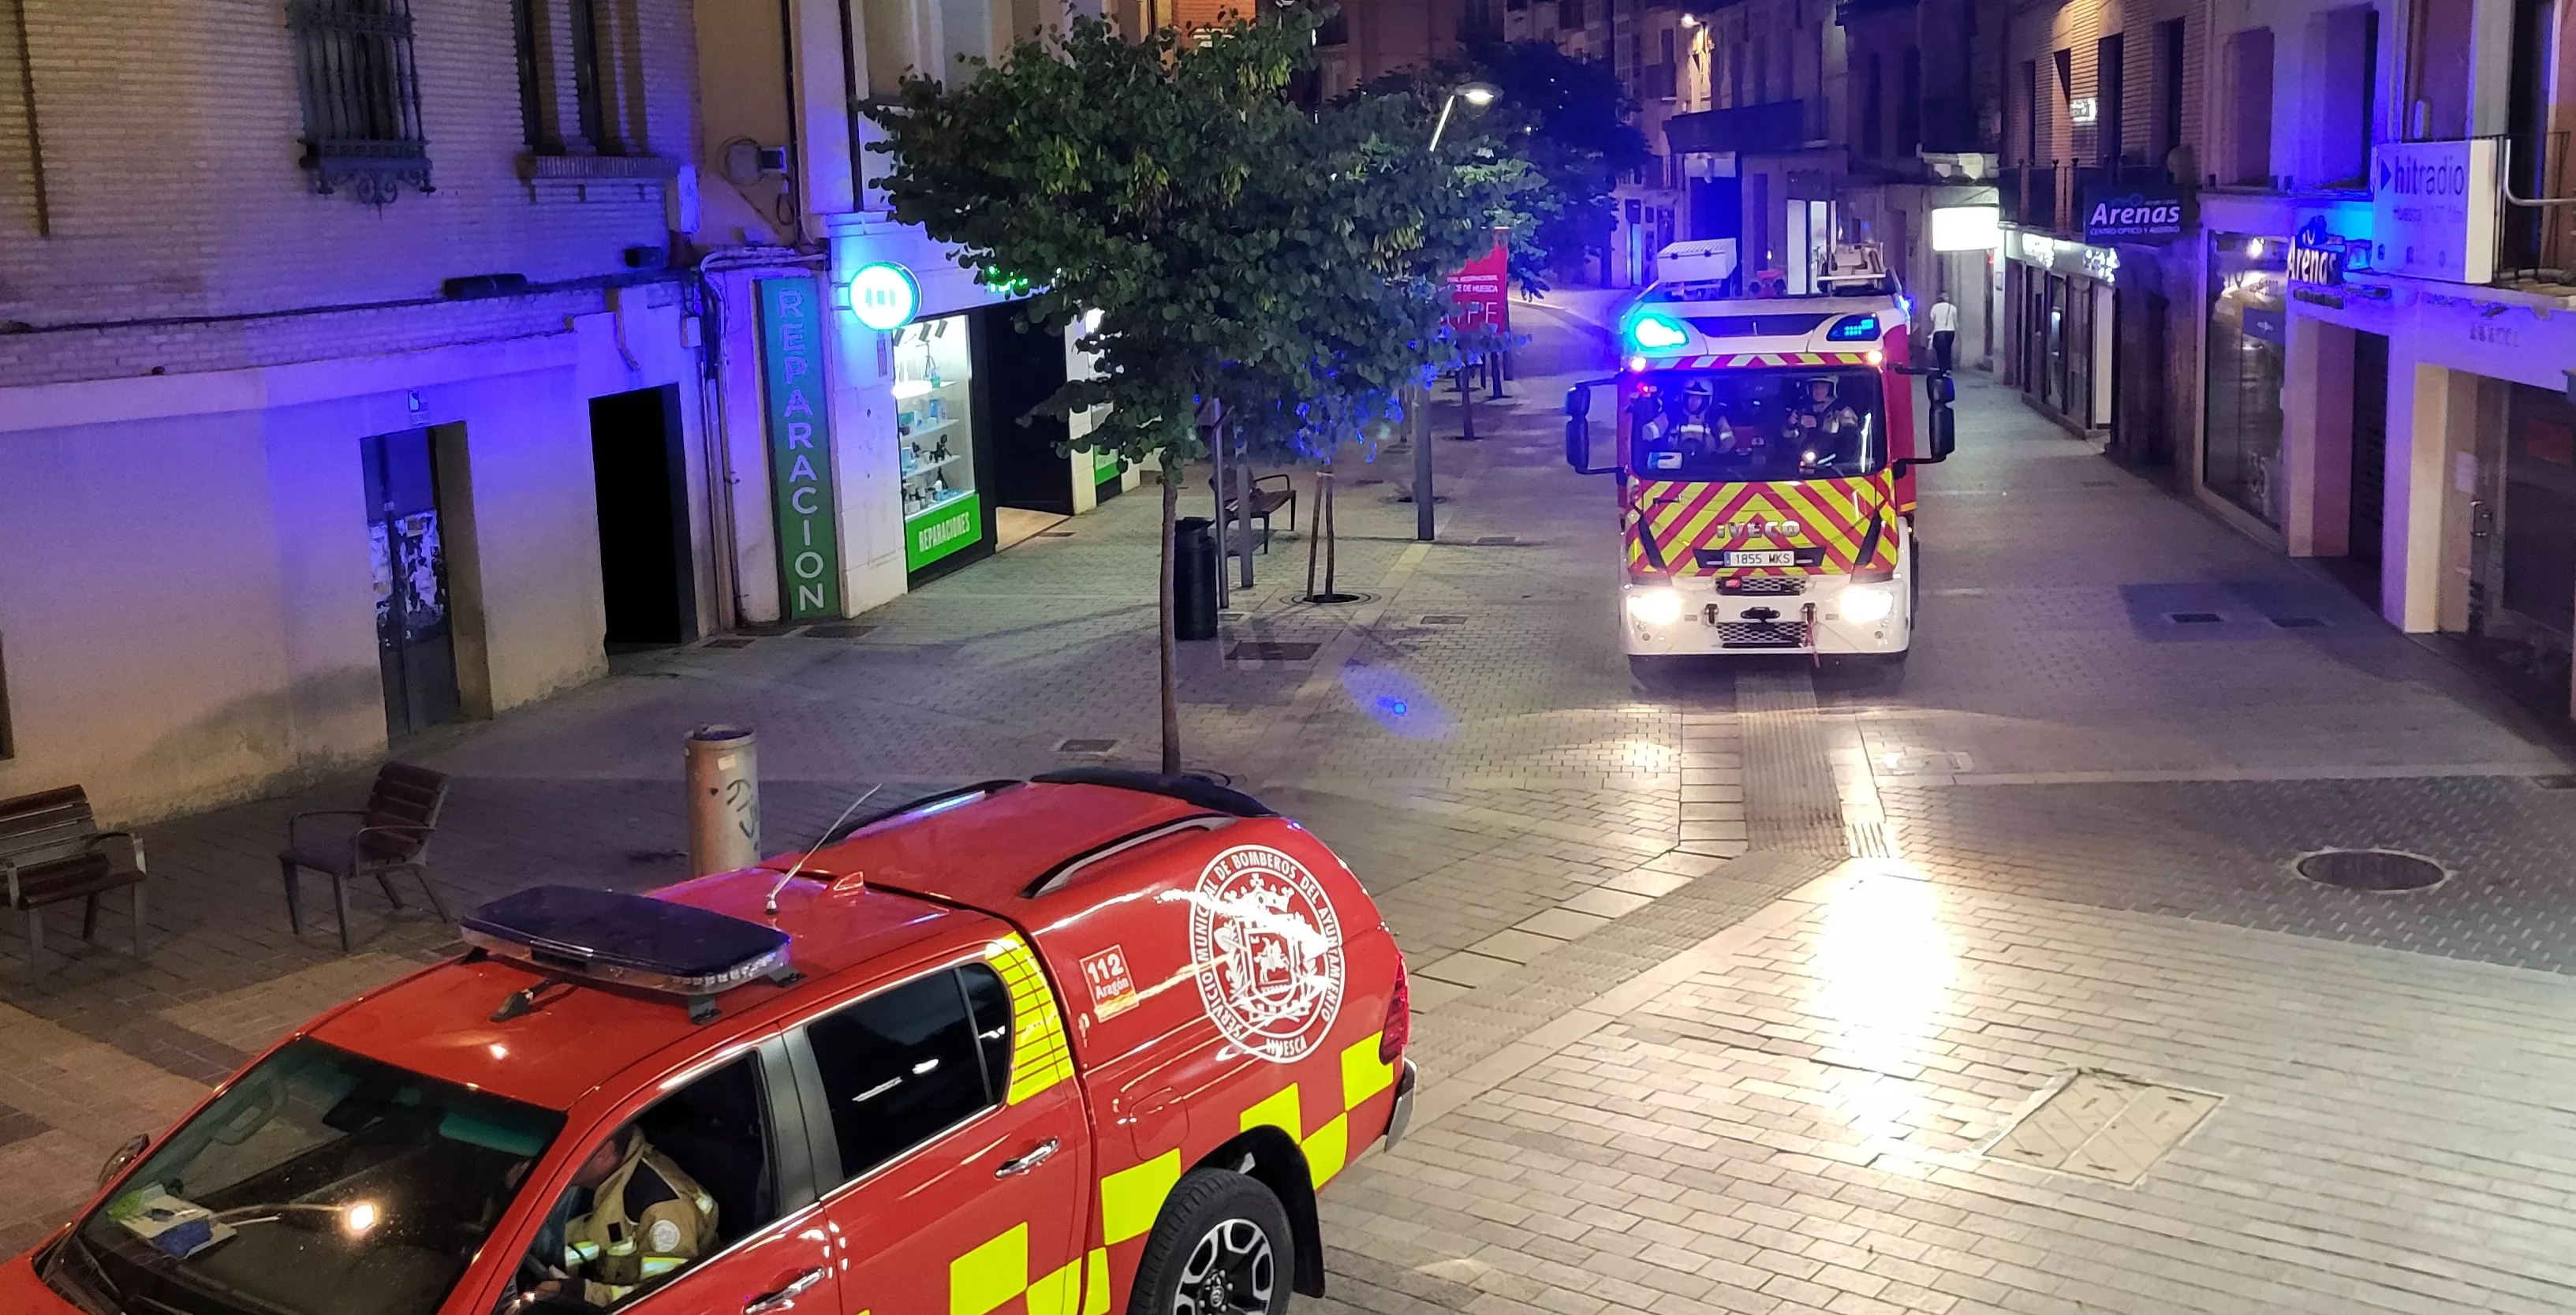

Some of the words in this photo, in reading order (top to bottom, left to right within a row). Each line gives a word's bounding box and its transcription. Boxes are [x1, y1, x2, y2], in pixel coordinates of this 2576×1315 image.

[2395, 155, 2465, 195] hitradio
[2090, 204, 2180, 225] Arenas
[2287, 235, 2338, 285] Arenas
[778, 290, 824, 611] REPARACION
[919, 511, 971, 552] REPARACIONES
[1717, 521, 1801, 538] IVECO
[1735, 554, 1762, 564] 1855
[1769, 554, 1790, 564] MKS
[1214, 861, 1232, 880] DE
[1231, 851, 1297, 879] BOMBEROS
[1300, 876, 1320, 905] DEL
[1195, 878, 1219, 962] MUNICAL
[1088, 953, 1124, 984] 112
[1317, 906, 1341, 1022] AYUNTAMIENTO
[1096, 977, 1129, 1000] Aragón
[1201, 972, 1244, 1038] SERVICIO
